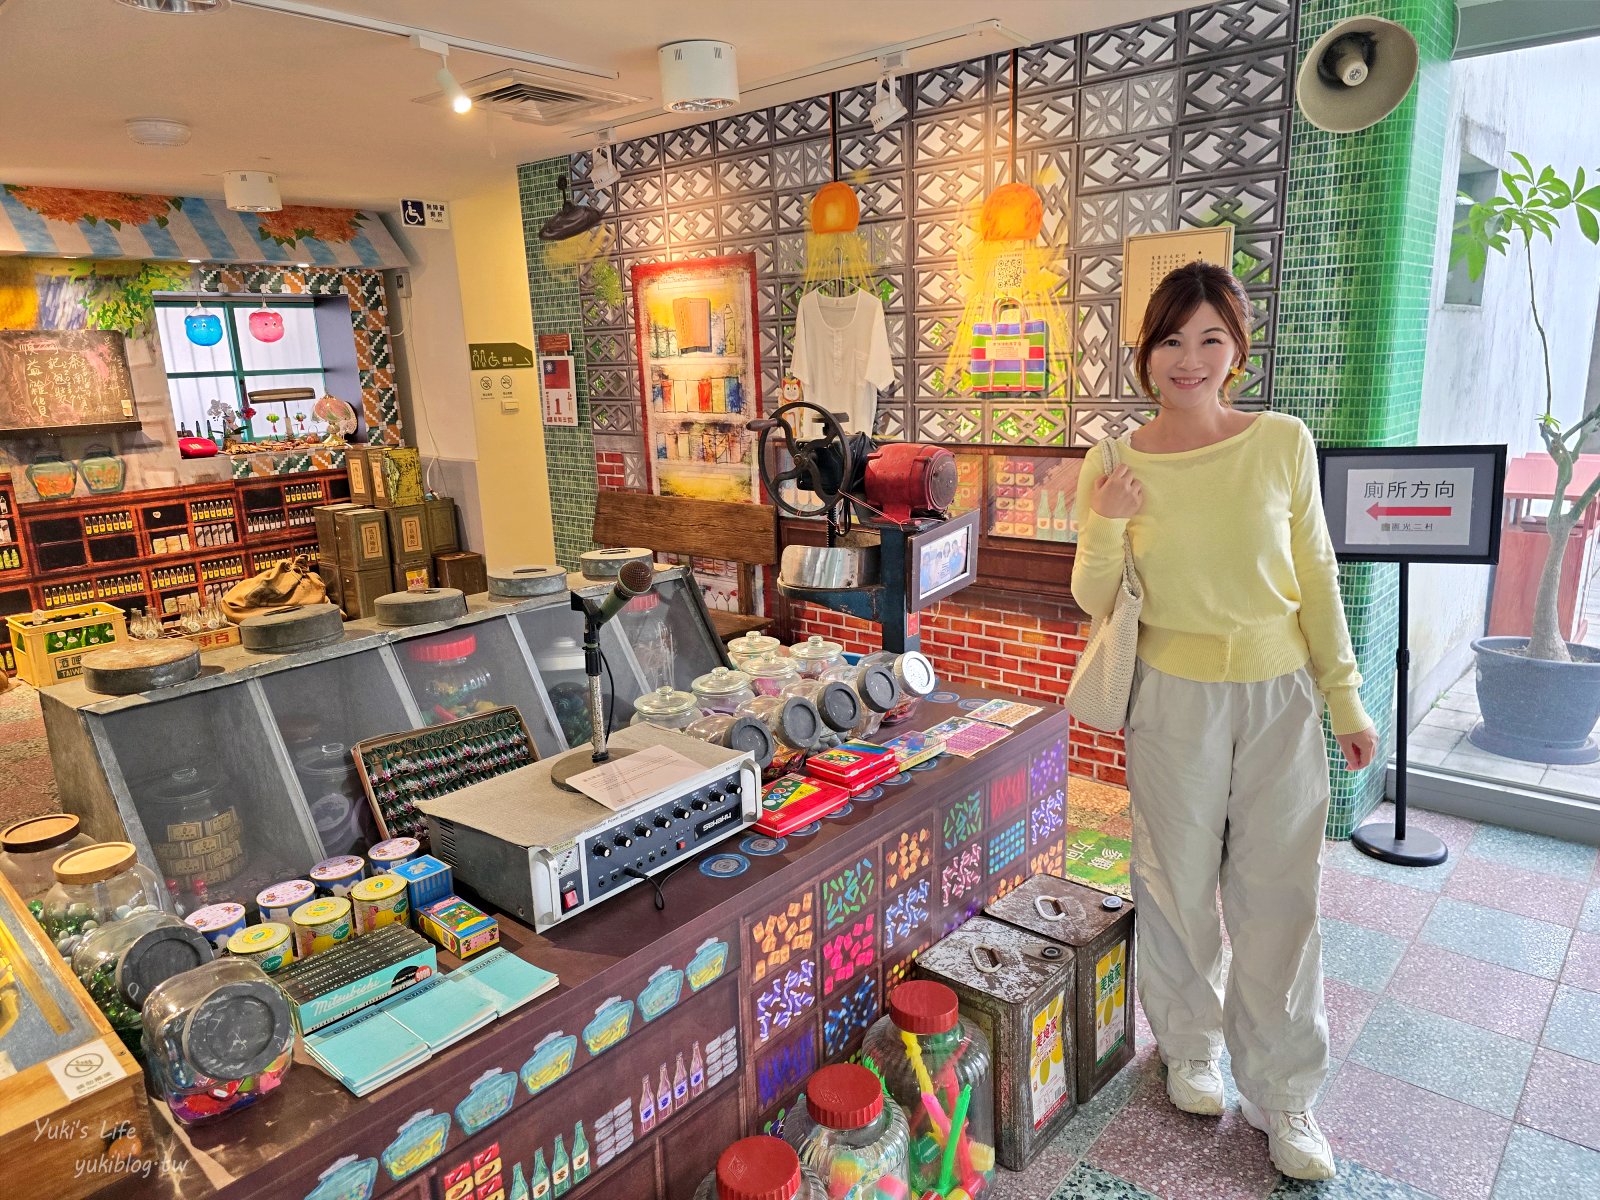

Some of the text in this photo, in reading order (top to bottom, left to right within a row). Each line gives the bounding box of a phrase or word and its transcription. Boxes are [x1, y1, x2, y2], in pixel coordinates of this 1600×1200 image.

[1364, 481, 1454, 499] 廁所方向
[1100, 962, 1122, 991] 美食家
[310, 977, 380, 1017] Mitsubishi
[1036, 1016, 1058, 1047] 美食家
